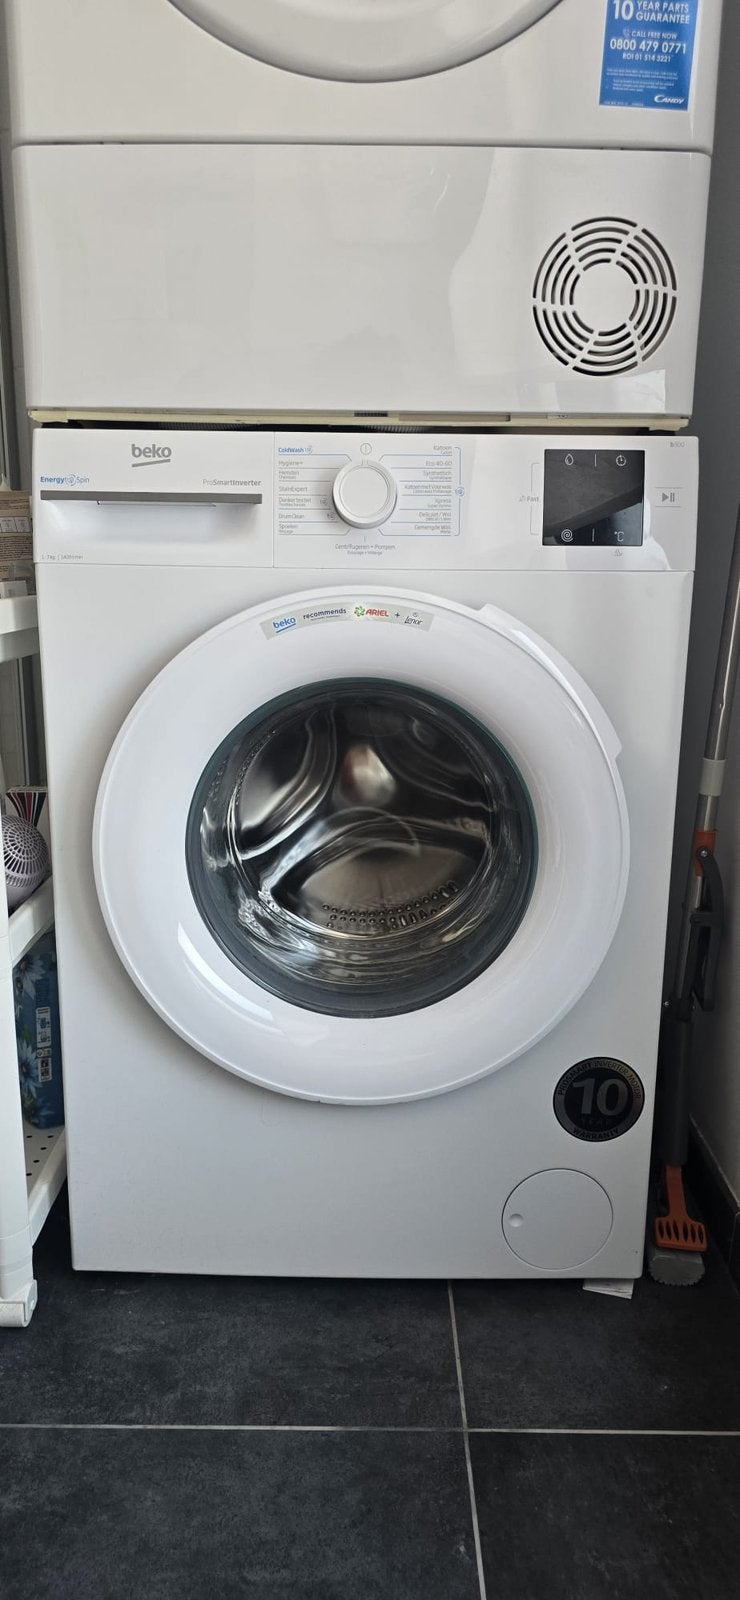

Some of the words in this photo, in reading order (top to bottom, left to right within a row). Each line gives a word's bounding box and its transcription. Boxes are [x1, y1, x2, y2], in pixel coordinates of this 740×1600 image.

[613, 0, 634, 21] 10
[637, 1, 660, 11] YEAR
[662, 2, 689, 14] PARTS
[635, 11, 690, 25] GUARANTEE
[631, 30, 646, 38] CALL
[647, 31, 660, 39] FREE
[661, 32, 677, 40] NOW
[609, 38, 637, 51] 0800
[639, 39, 659, 53] 479
[661, 41, 687, 55] 0771
[622, 52, 634, 60] ROI
[131, 443, 172, 458] beko
[40, 476, 65, 485] Energy
[76, 476, 90, 485] Spin
[202, 479, 262, 487] ProSmartInverter
[272, 617, 297, 629] beko
[303, 607, 347, 620] recommends
[365, 608, 389, 617] ARIEL
[594, 1060, 630, 1076] INVERTER
[572, 1077, 630, 1117] 10
[572, 1127, 620, 1141] WARRANTY
